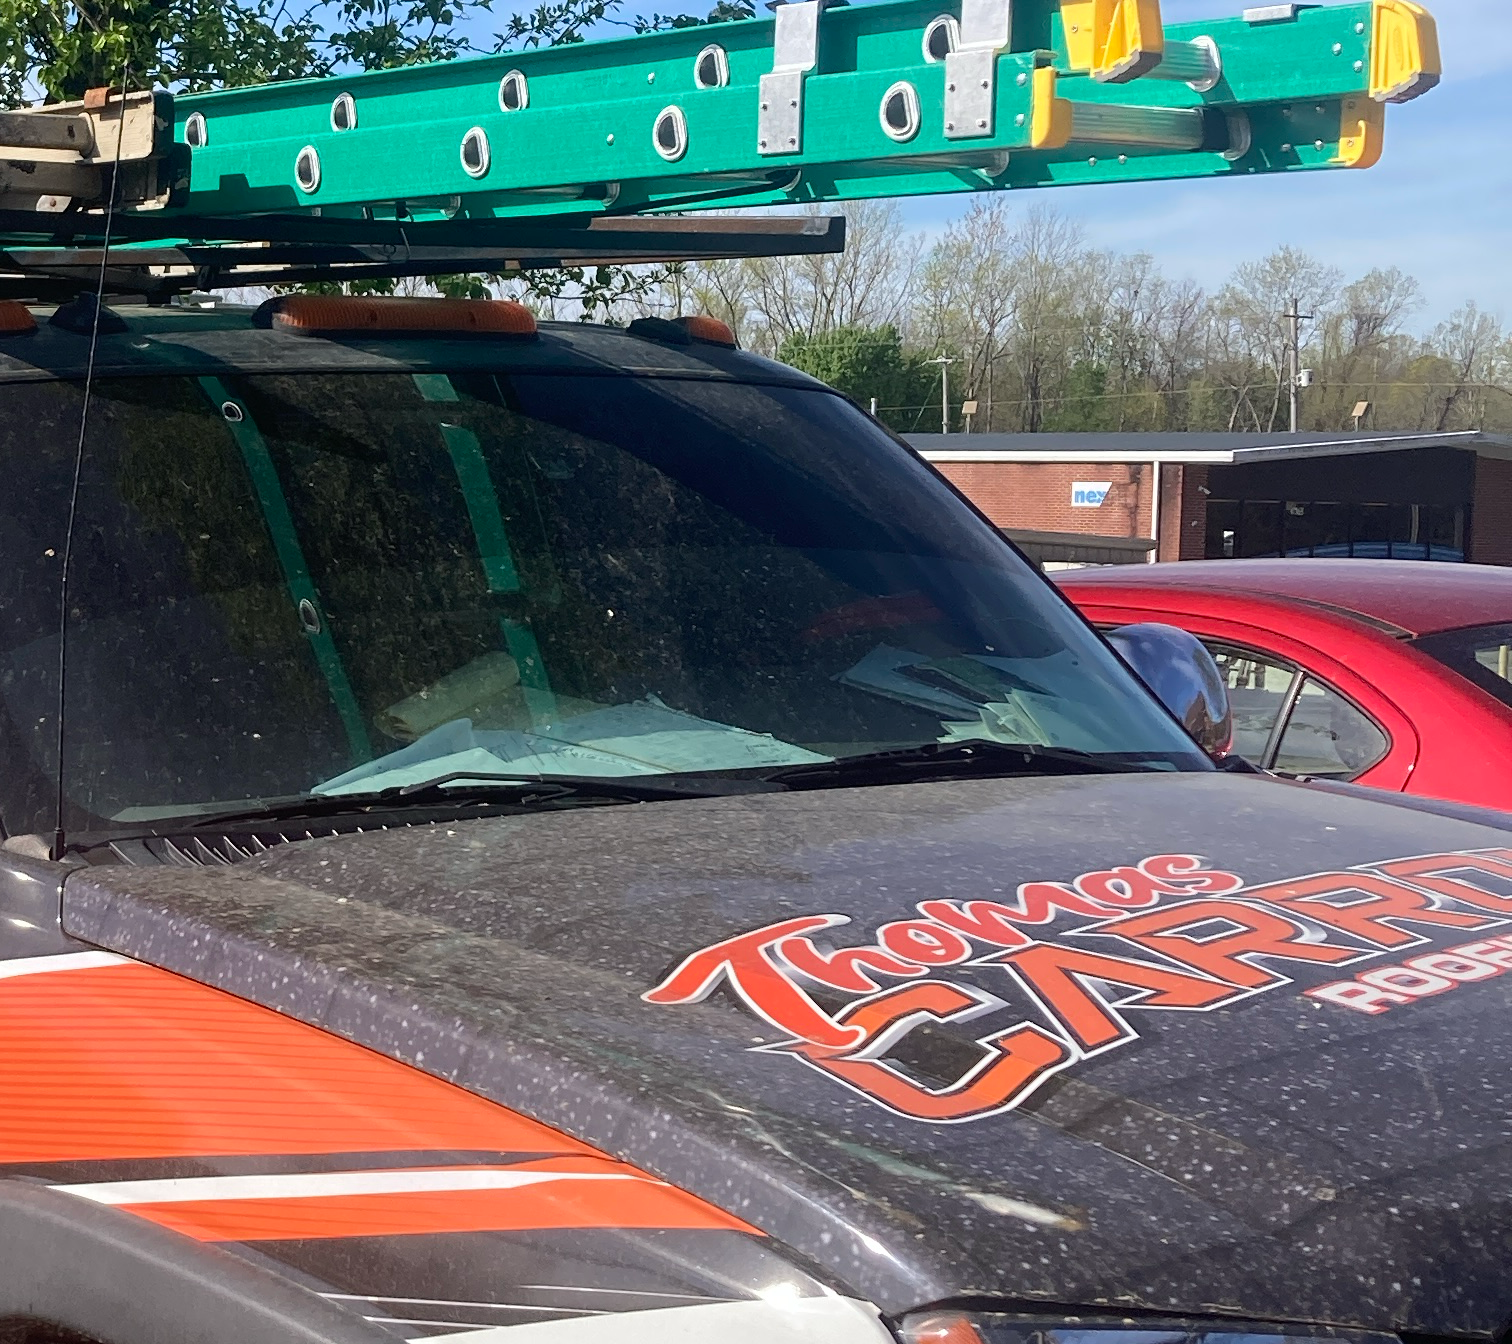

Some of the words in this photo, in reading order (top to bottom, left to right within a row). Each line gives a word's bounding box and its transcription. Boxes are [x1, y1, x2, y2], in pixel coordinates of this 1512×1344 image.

[641, 855, 1245, 1049] Thomas
[746, 847, 1512, 1124] CARRO
[1303, 932, 1512, 1016] ROOF
